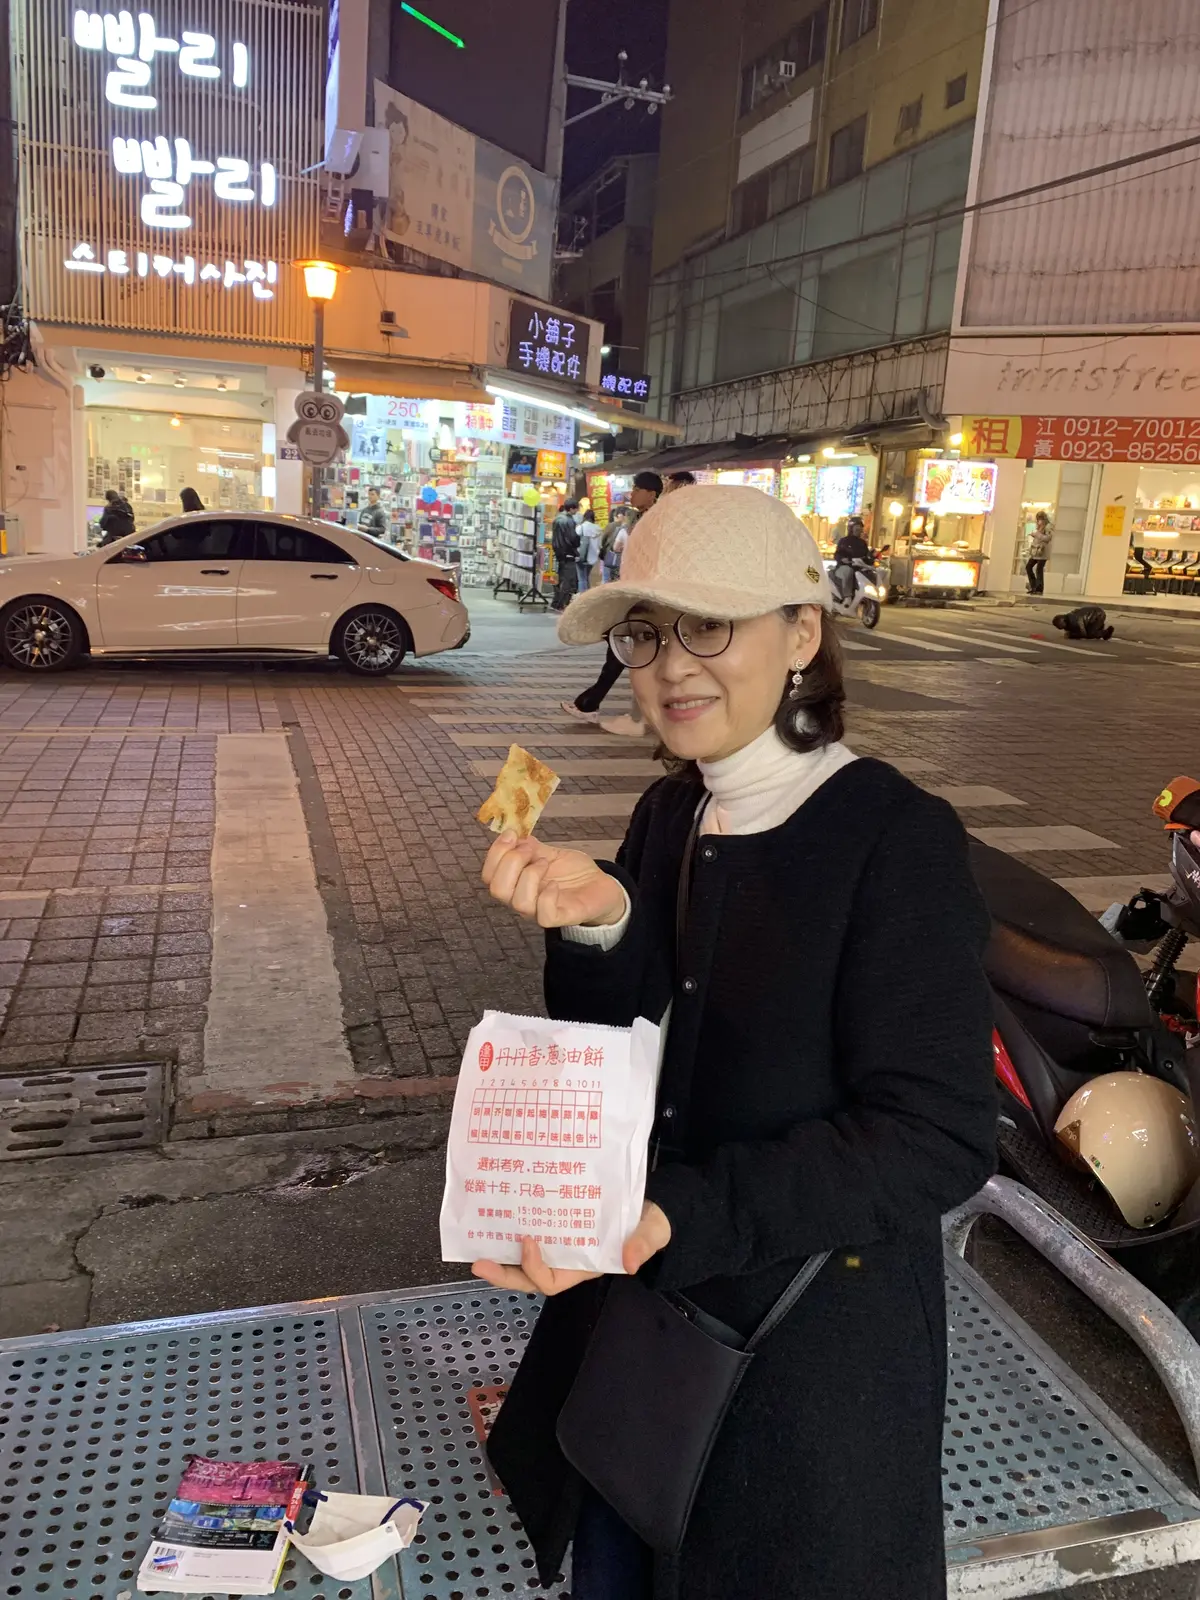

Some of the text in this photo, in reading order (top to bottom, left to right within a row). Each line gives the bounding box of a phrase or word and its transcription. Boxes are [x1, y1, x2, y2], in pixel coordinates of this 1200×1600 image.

[73, 9, 248, 109] 빨리
[112, 135, 276, 229] 빨리
[63, 241, 277, 299] 스티커사진
[528, 311, 576, 348] 小舖子
[519, 341, 580, 379] 手機配件
[996, 352, 1200, 400] innisfree
[601, 374, 648, 396] 機配件
[388, 400, 419, 418] 250
[1035, 417, 1057, 436] 江
[970, 417, 1010, 455] 租
[1033, 439, 1200, 463] 黃 0923-85256
[467, 1230, 600, 1247] 台中市西屯區甲路21號(轉角)
